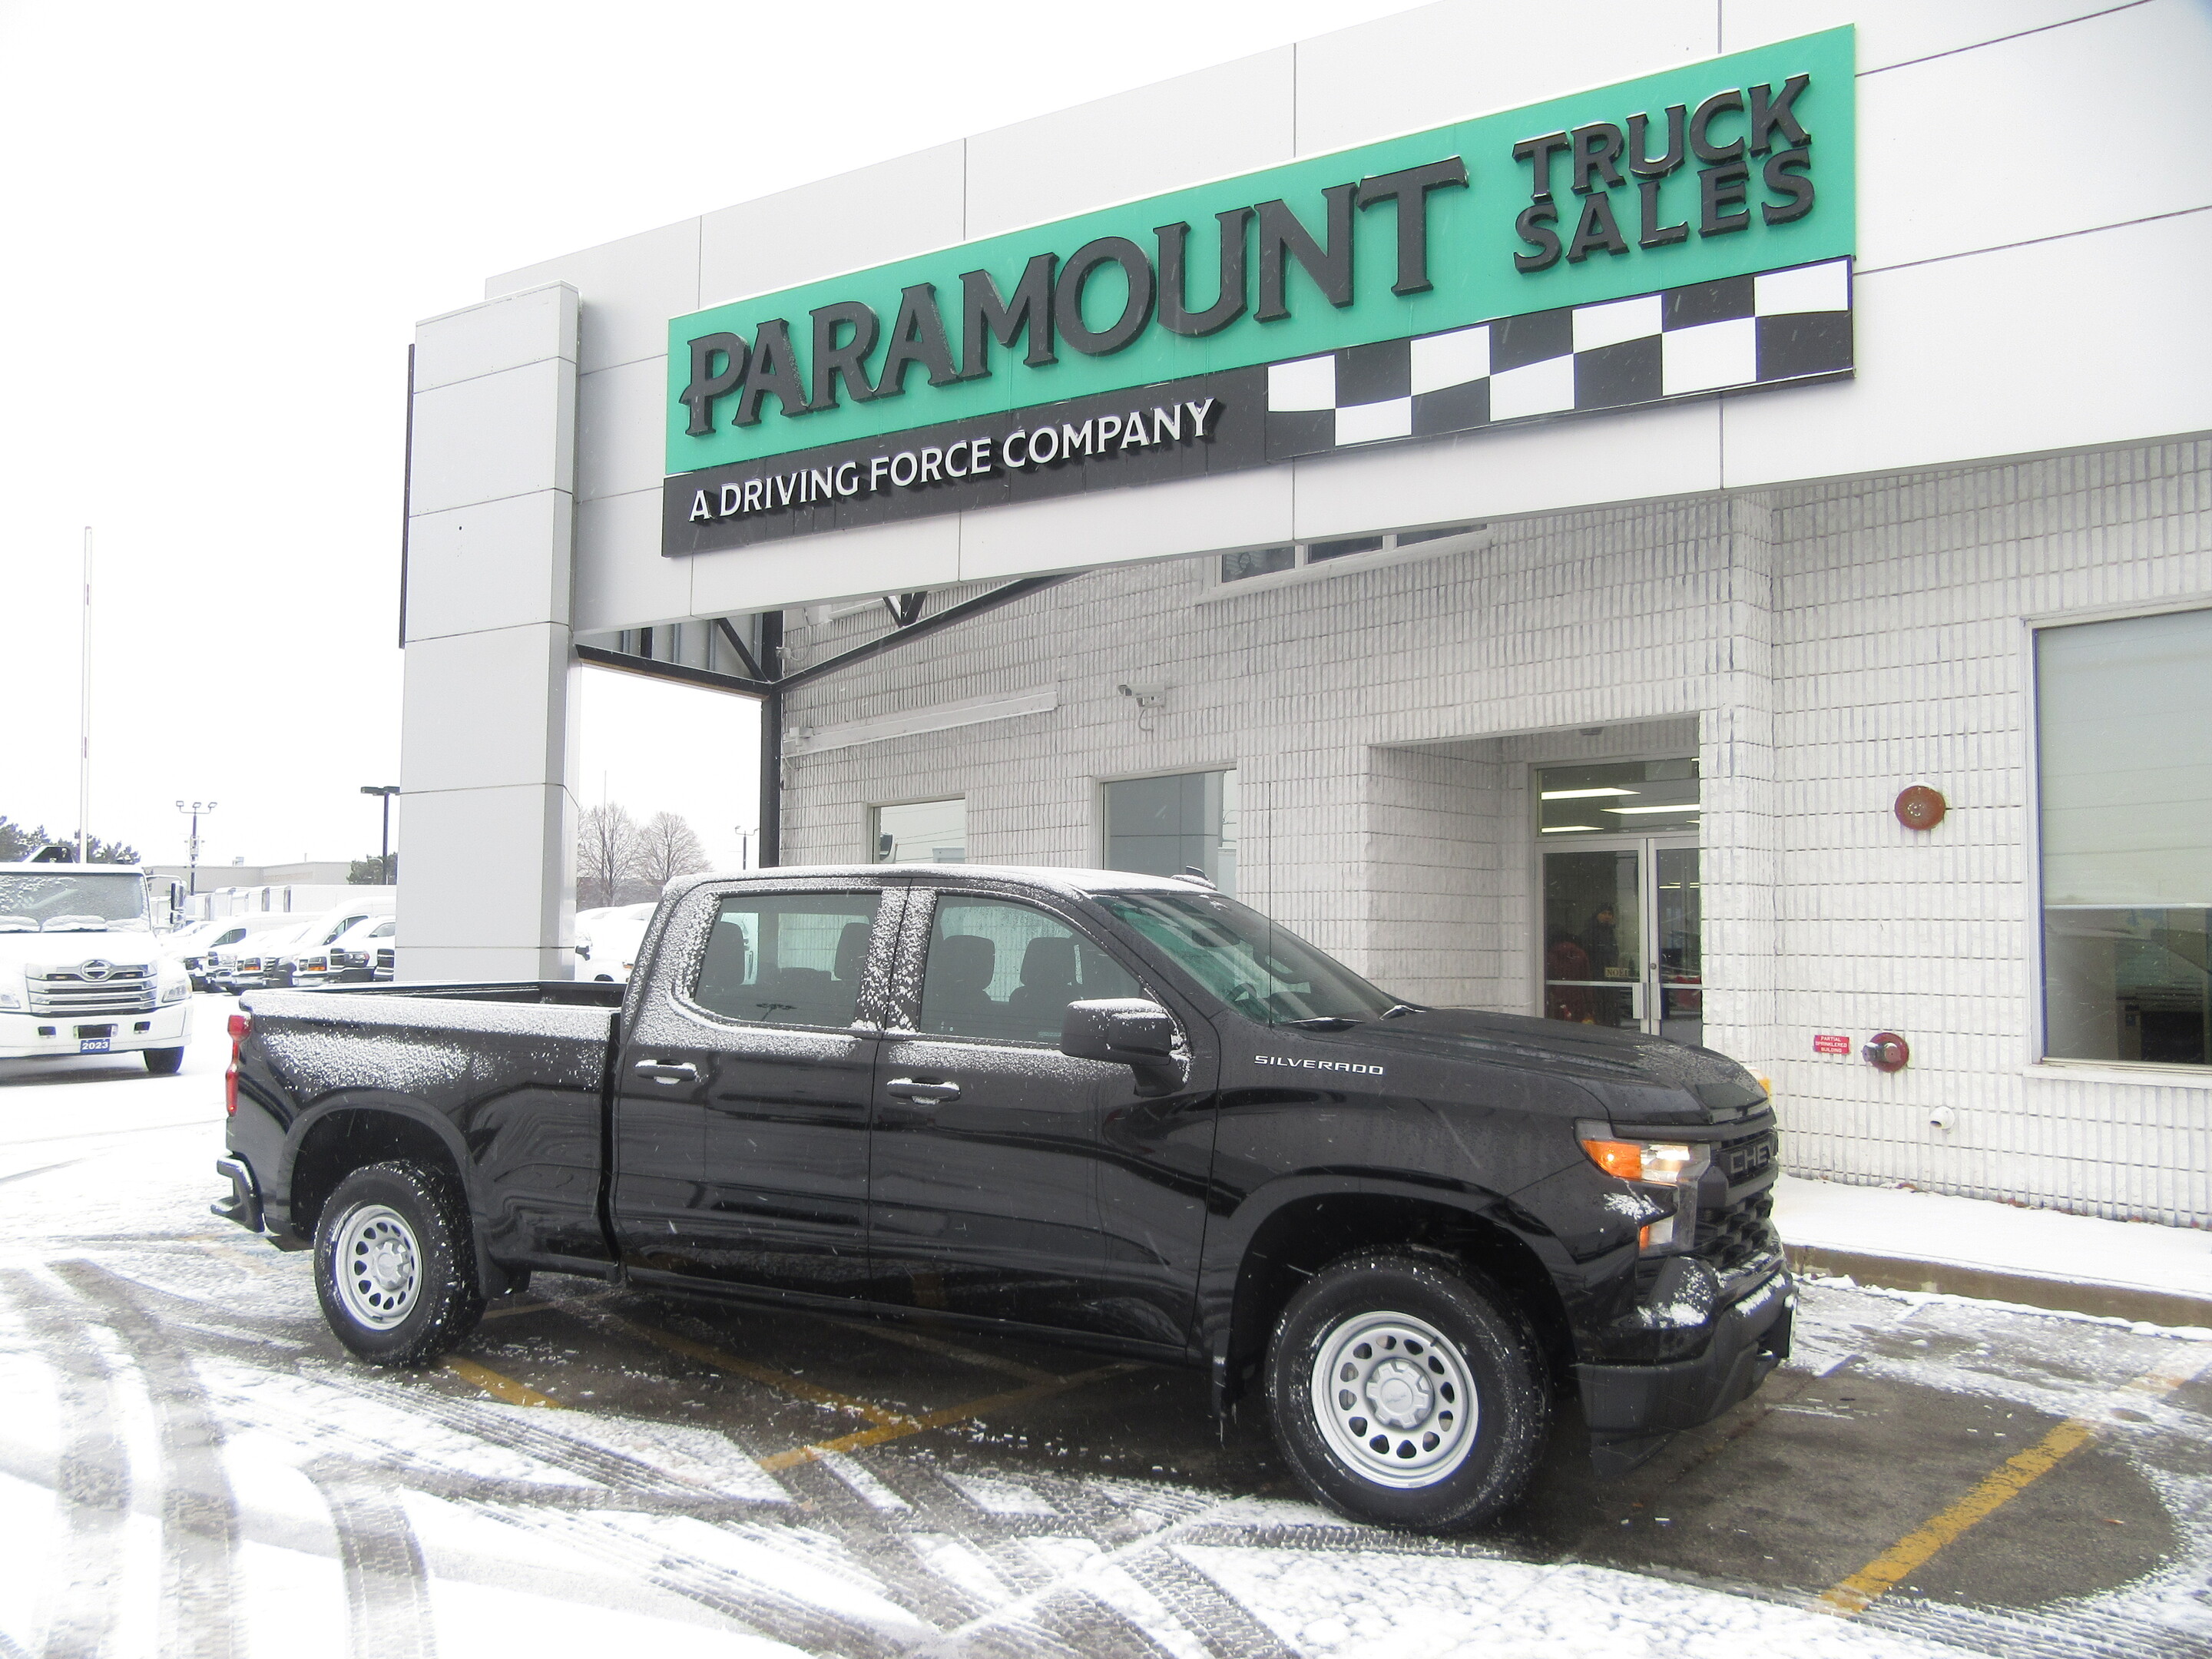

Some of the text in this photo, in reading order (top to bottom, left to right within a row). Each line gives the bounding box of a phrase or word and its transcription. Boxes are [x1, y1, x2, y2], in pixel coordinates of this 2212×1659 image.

[1512, 74, 1812, 204] TRUCK
[1513, 147, 1814, 275] SALES
[679, 157, 1469, 438] PARAMOUNT
[689, 397, 1216, 522] A DRIVING FORCE COMPANY
[81, 1041, 109, 1050] 2023
[1254, 1055, 1383, 1075] SILVERADO
